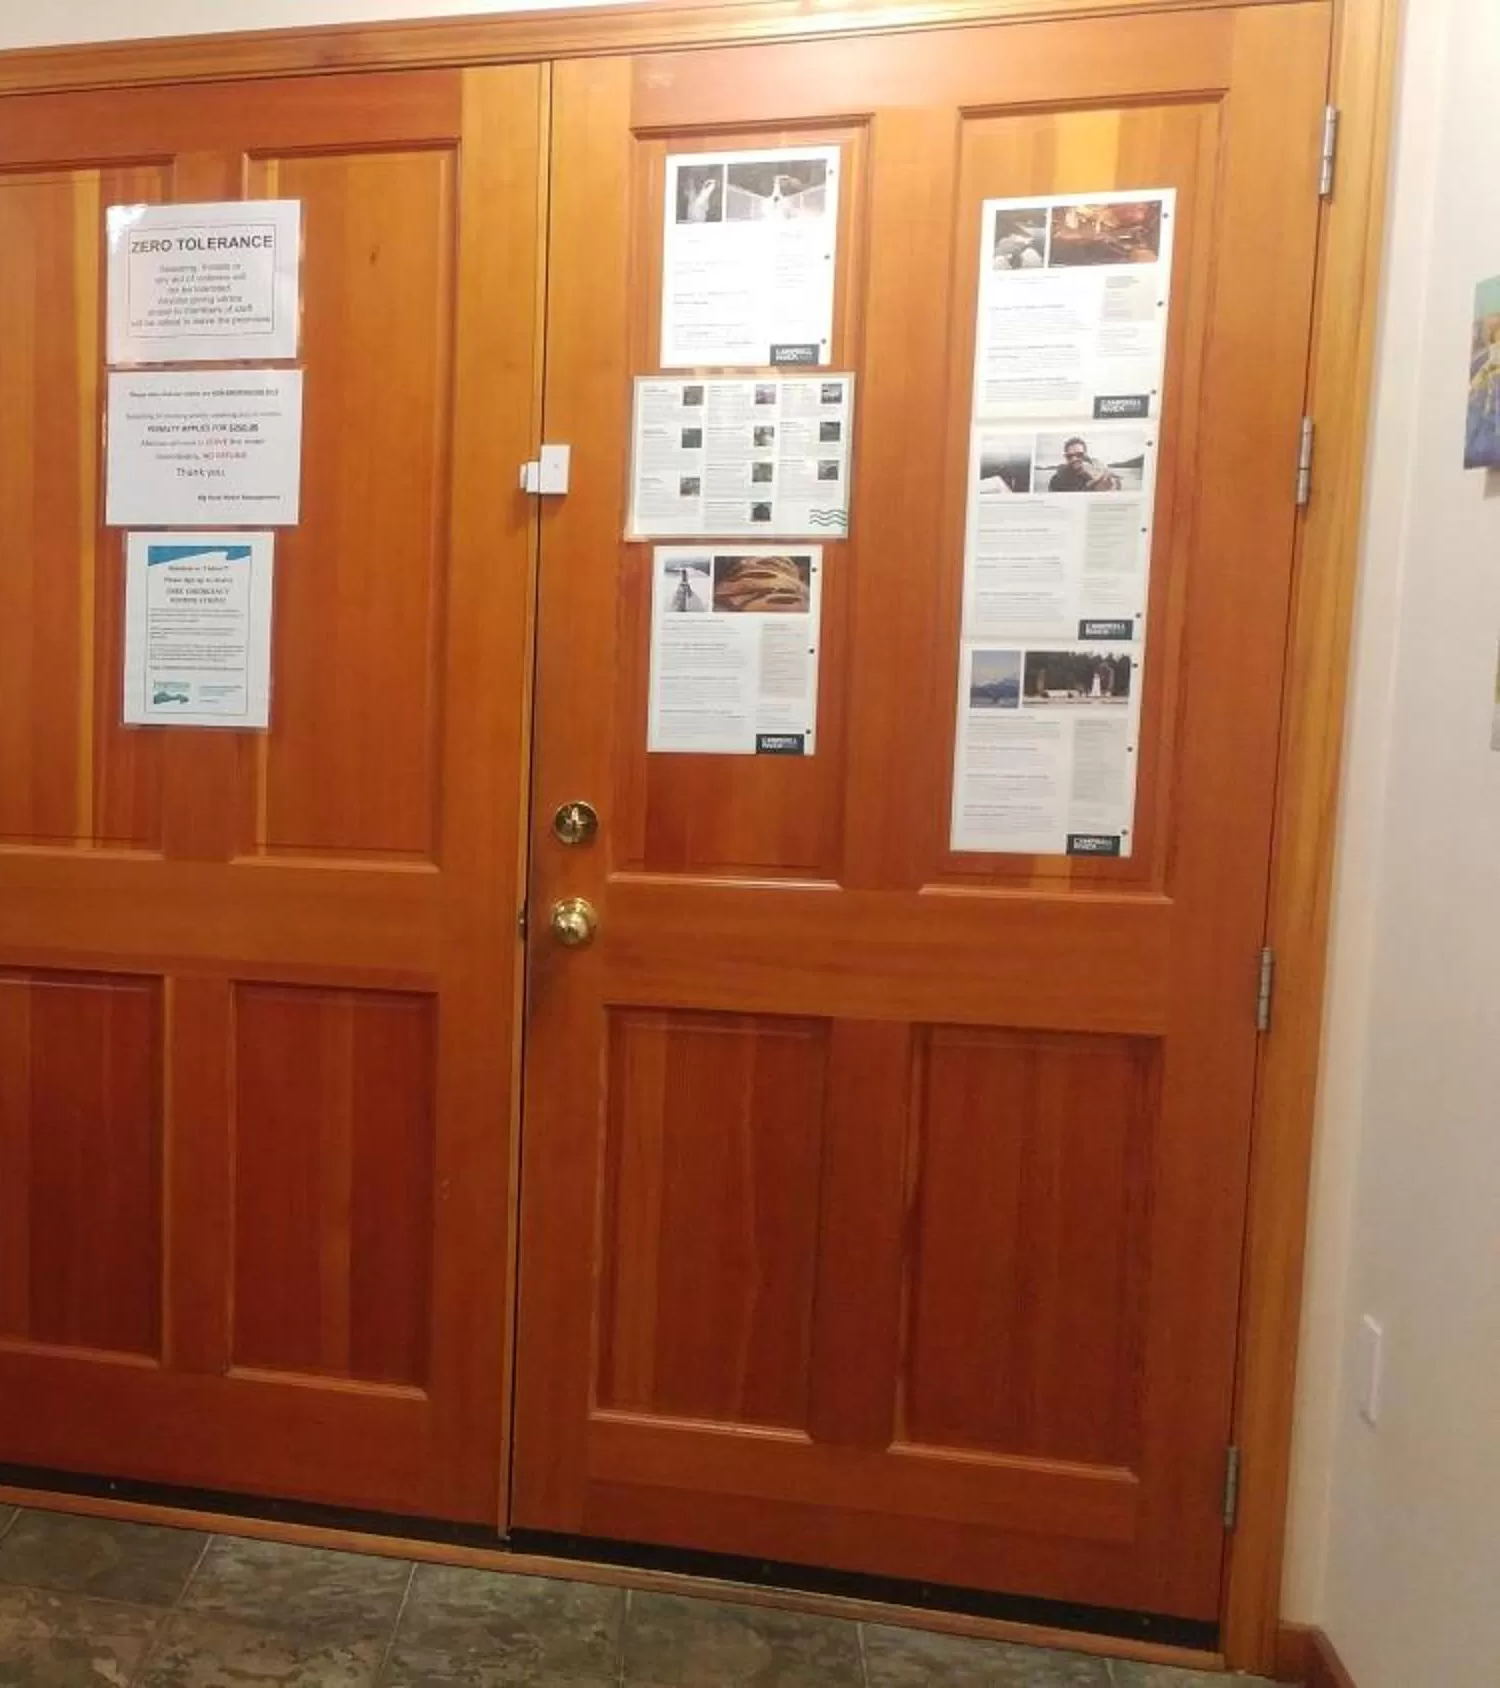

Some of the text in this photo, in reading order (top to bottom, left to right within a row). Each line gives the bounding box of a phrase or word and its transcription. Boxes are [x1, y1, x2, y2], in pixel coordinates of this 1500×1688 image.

[131, 235, 274, 253] ZERO TOLERANCE
[176, 467, 205, 477] Thank
